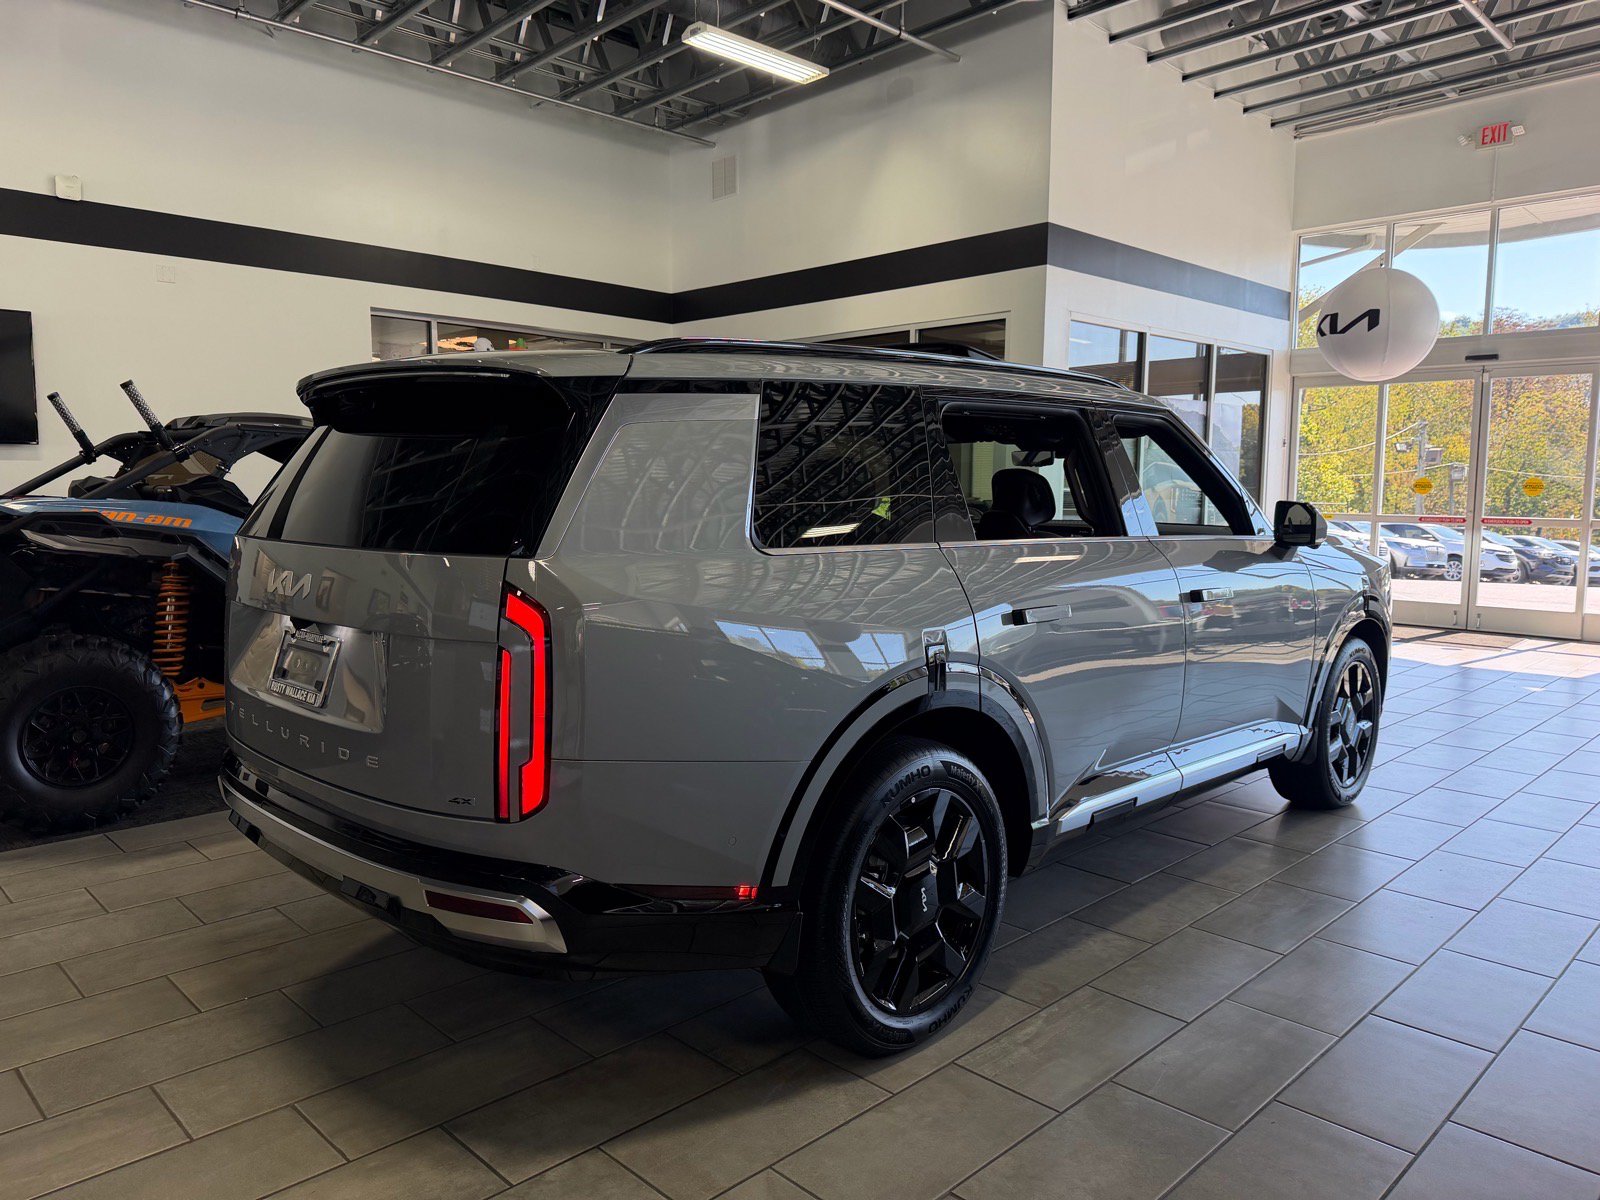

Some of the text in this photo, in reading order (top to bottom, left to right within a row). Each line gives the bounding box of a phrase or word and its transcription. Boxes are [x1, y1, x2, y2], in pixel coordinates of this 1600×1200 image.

[1481, 122, 1509, 145] EXIT
[82, 508, 192, 528] an-am
[267, 568, 312, 599] KIA
[286, 685, 307, 700] WALLACE
[306, 692, 315, 704] KIA
[229, 701, 379, 768] TELLURIDE
[880, 765, 931, 808] KUMHO
[950, 765, 976, 786] Majesty
